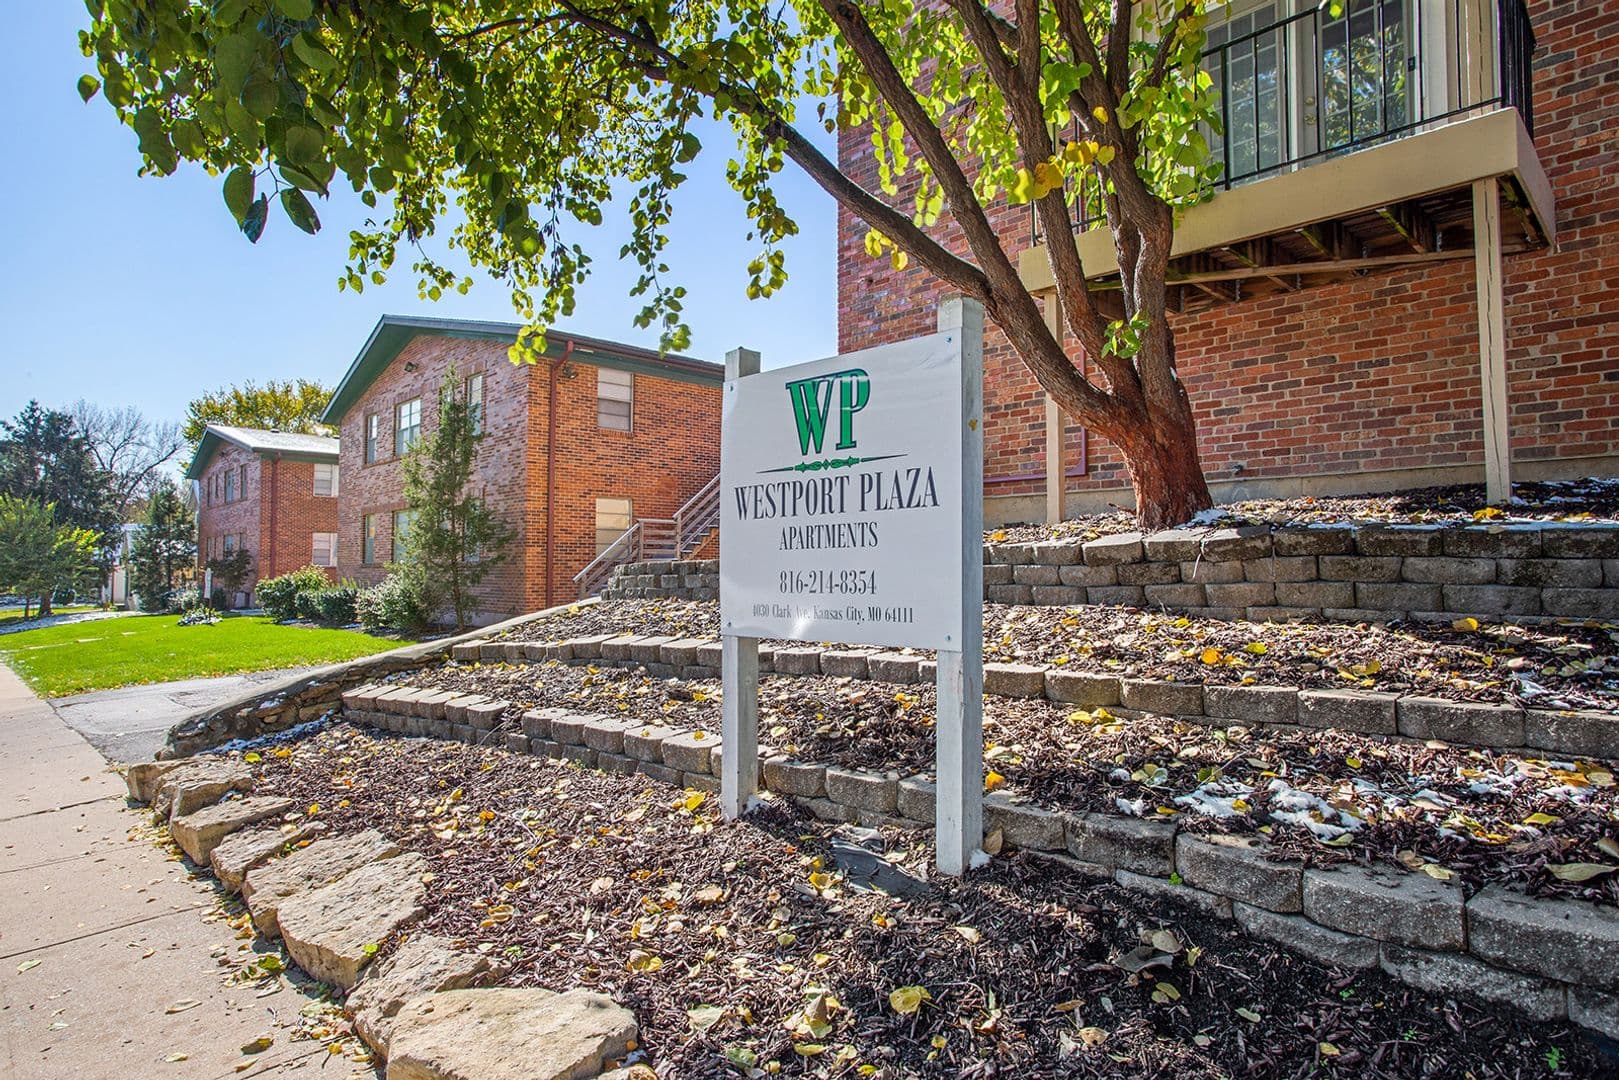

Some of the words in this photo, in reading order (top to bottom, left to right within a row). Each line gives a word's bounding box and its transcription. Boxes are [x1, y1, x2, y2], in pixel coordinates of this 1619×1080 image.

[785, 368, 871, 456] WP
[734, 475, 850, 521] WESTPORT
[859, 466, 940, 512] PLAZA
[779, 521, 879, 550] APARTMENTS
[779, 569, 877, 594] 816-214-8354
[753, 604, 770, 617] 4030
[772, 604, 792, 618] Clark
[814, 605, 843, 620] Kansas
[867, 607, 882, 622] MO
[884, 607, 913, 623] 64111
